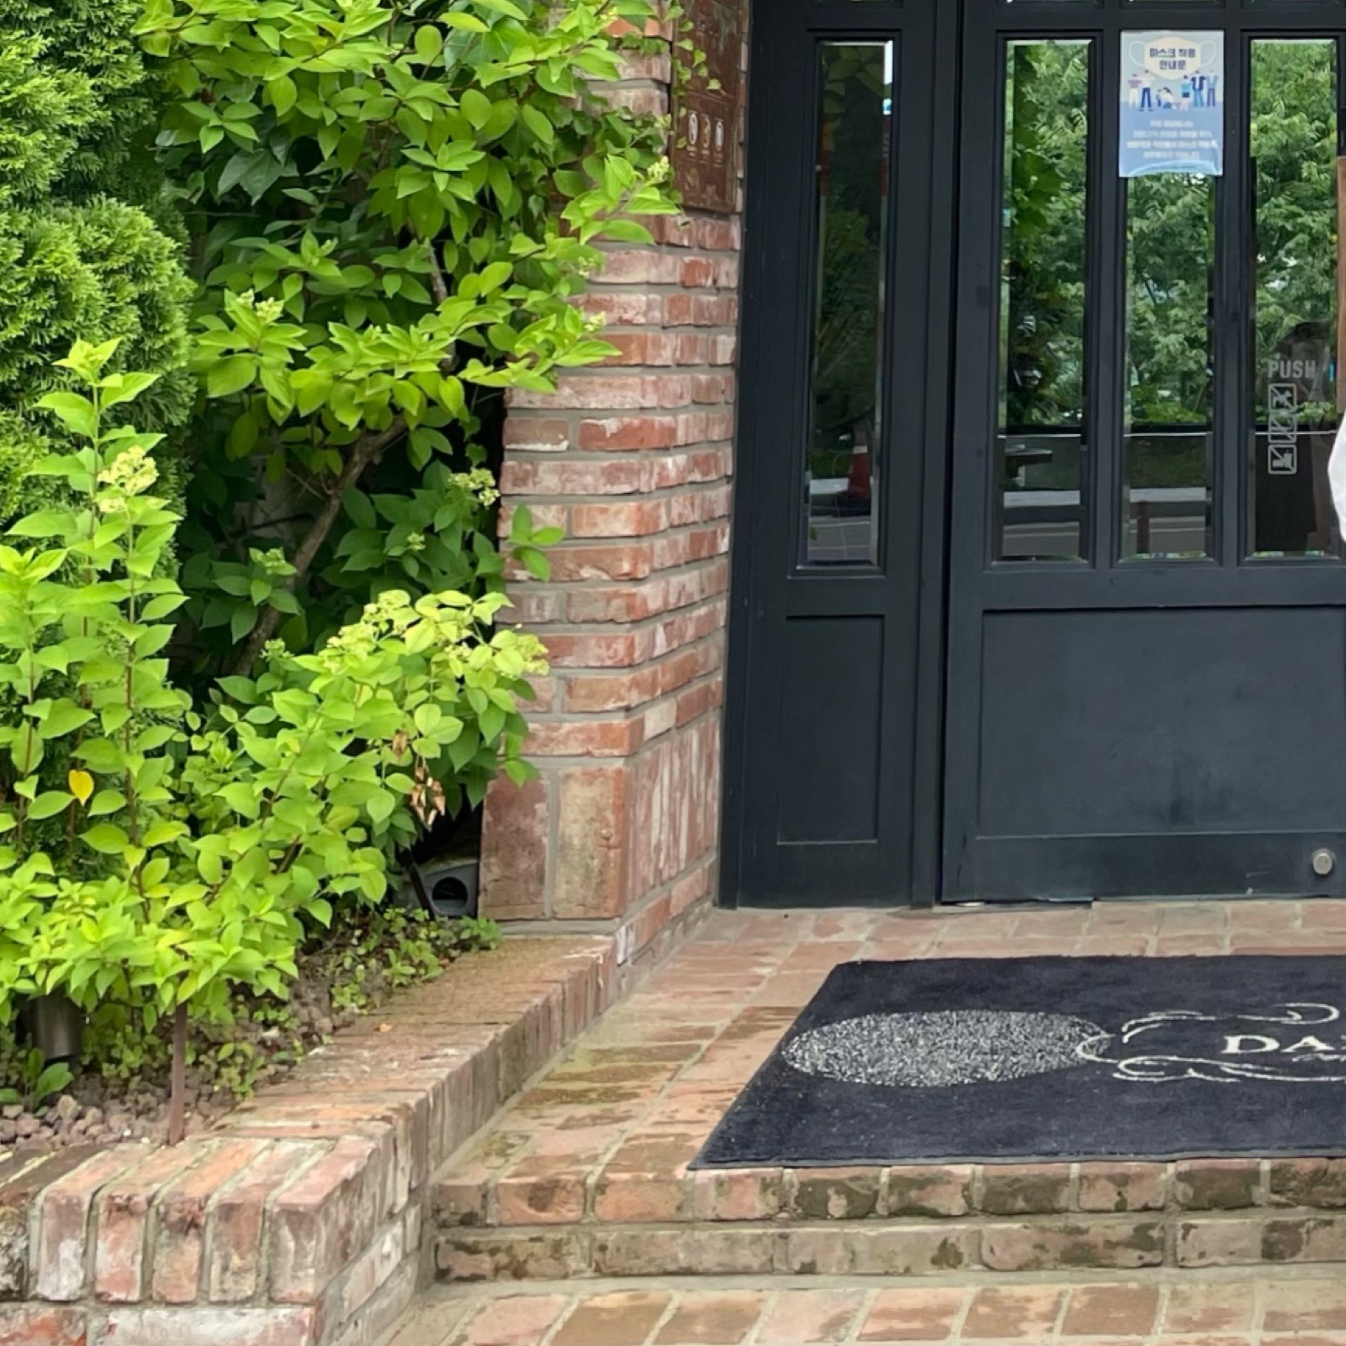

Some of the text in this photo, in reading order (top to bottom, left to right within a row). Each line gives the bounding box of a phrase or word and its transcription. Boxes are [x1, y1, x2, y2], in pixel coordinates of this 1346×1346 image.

[1150, 48, 1176, 57] 마스크
[1159, 60, 1187, 70] 안내문
[1267, 360, 1316, 378] PUSH
